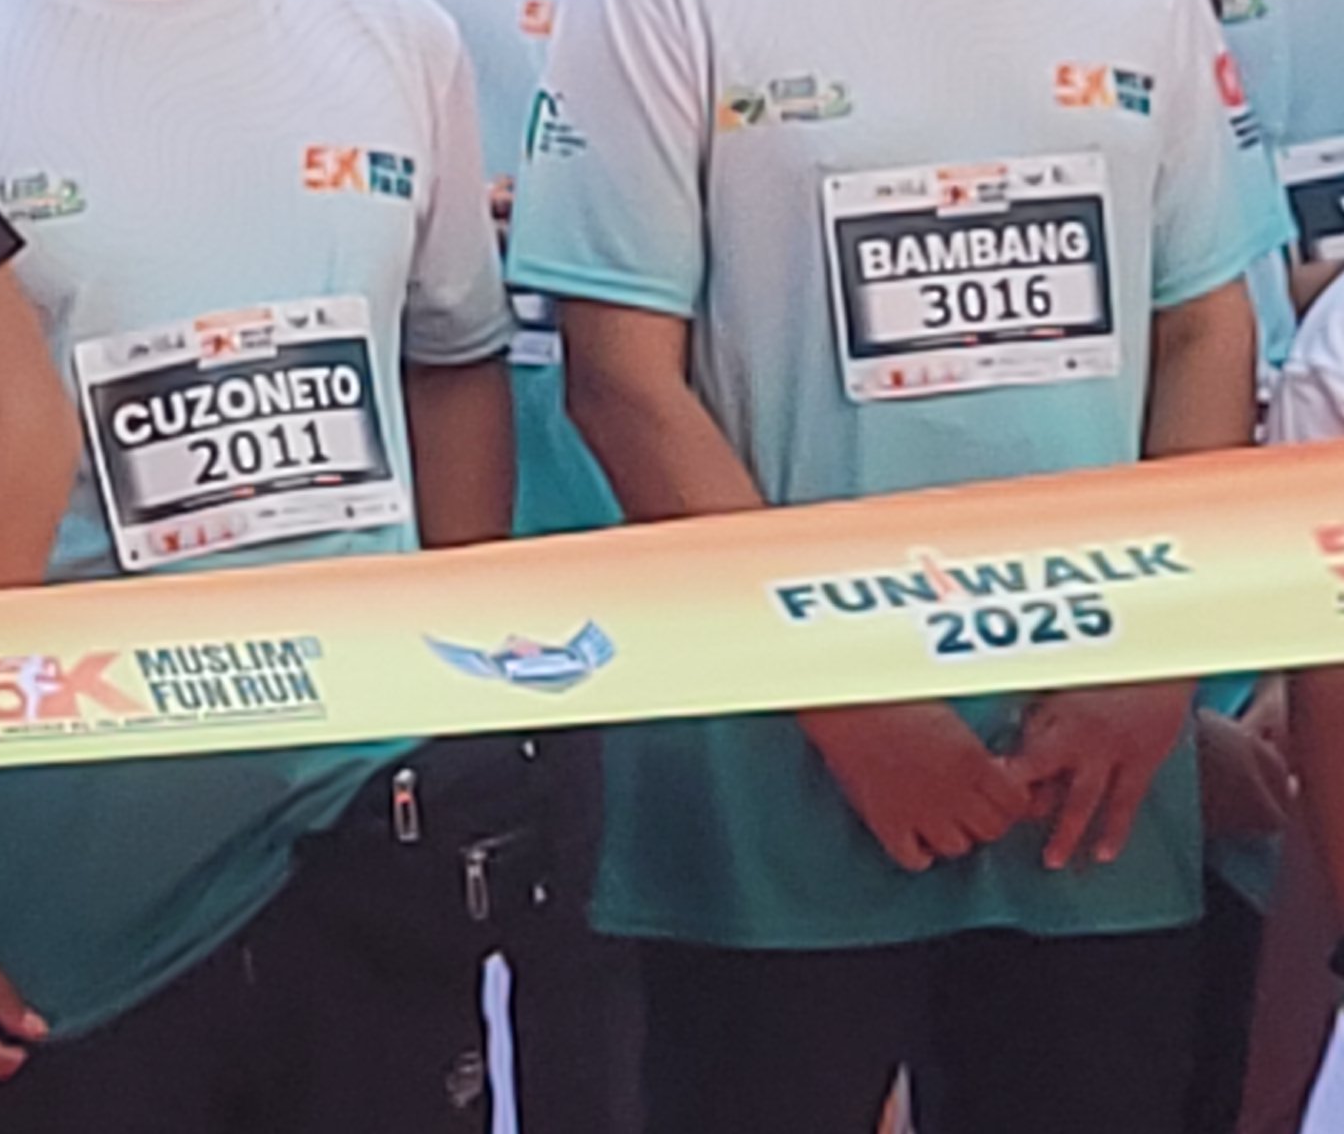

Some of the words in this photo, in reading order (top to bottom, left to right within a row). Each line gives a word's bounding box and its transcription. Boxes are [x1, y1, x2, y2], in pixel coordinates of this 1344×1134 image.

[858, 220, 1090, 279] BAMBANG
[919, 274, 1053, 329] 3016
[112, 365, 362, 446] CUZONETO
[187, 419, 331, 485] 2011
[774, 569, 943, 620] FUN
[944, 542, 1190, 594] WALK
[926, 592, 1114, 655] 2025
[134, 639, 304, 681] MUSLIM
[150, 676, 233, 714] FUN
[231, 670, 320, 709] RUN
